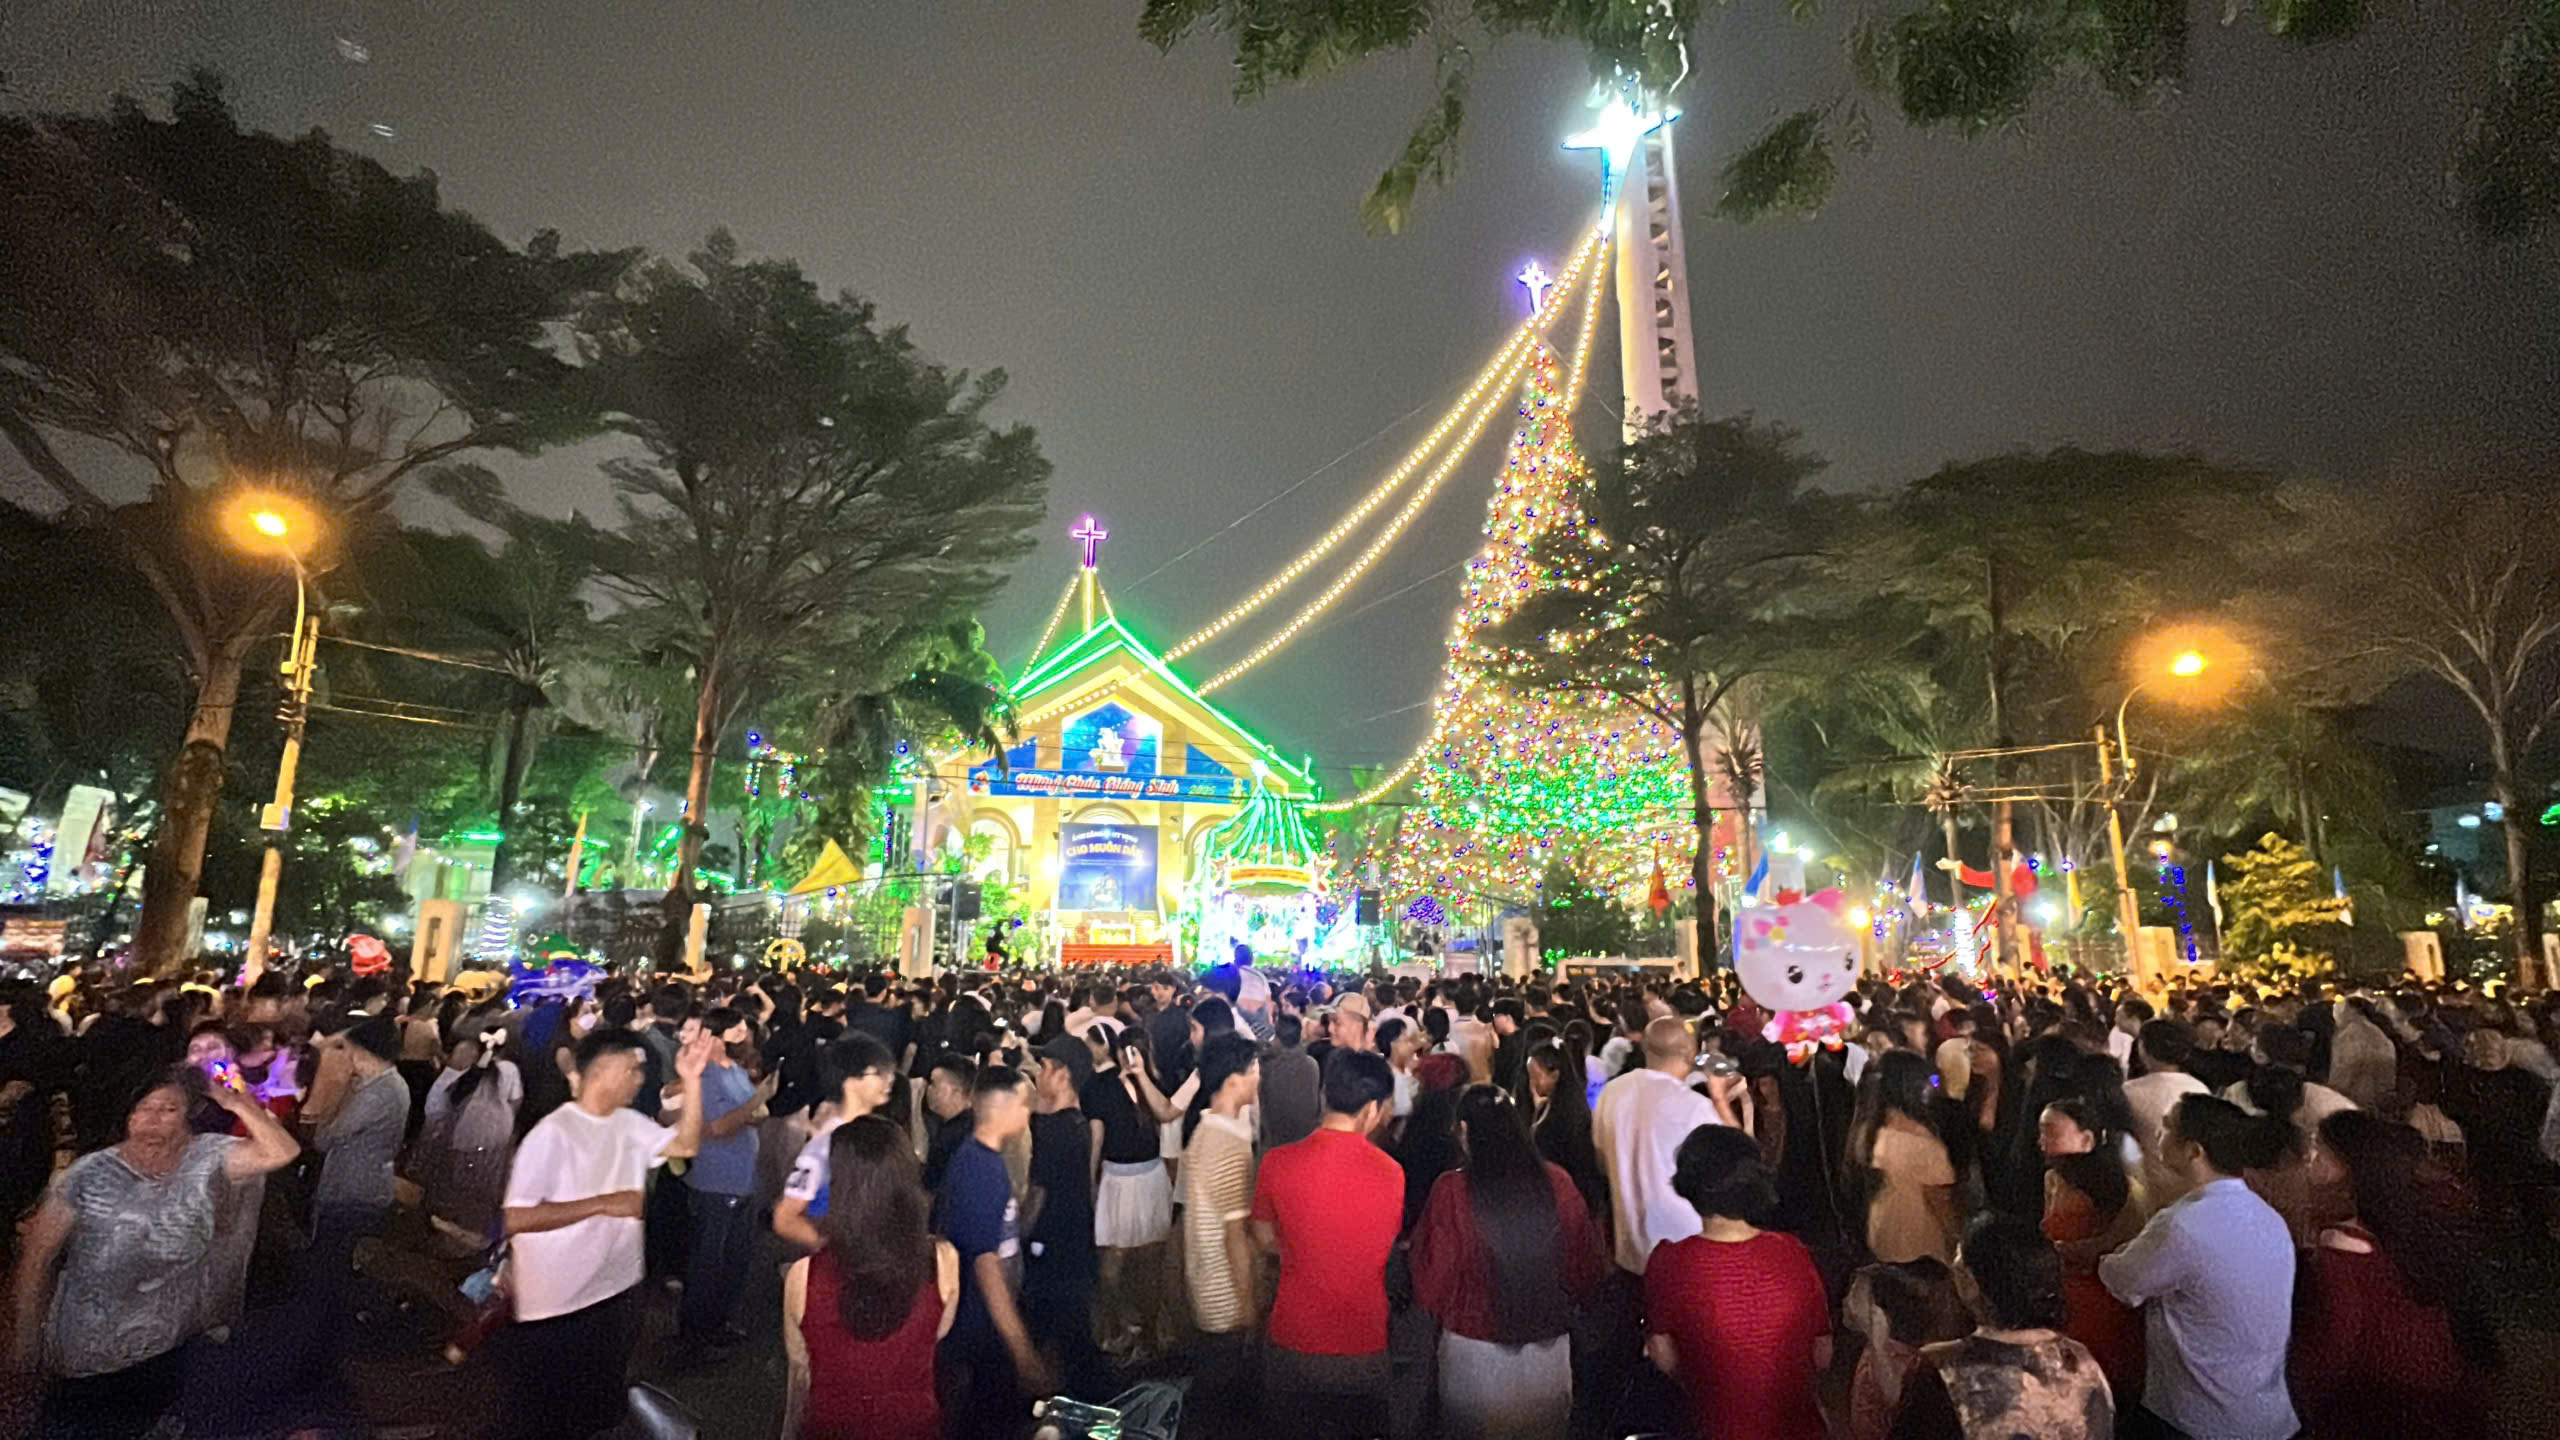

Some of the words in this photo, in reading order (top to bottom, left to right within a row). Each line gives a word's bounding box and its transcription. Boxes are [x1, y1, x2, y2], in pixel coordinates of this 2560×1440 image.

[1145, 777, 1180, 796] Sinh
[1066, 843, 1088, 856] CHO
[1088, 840, 1121, 853] MUÔN
